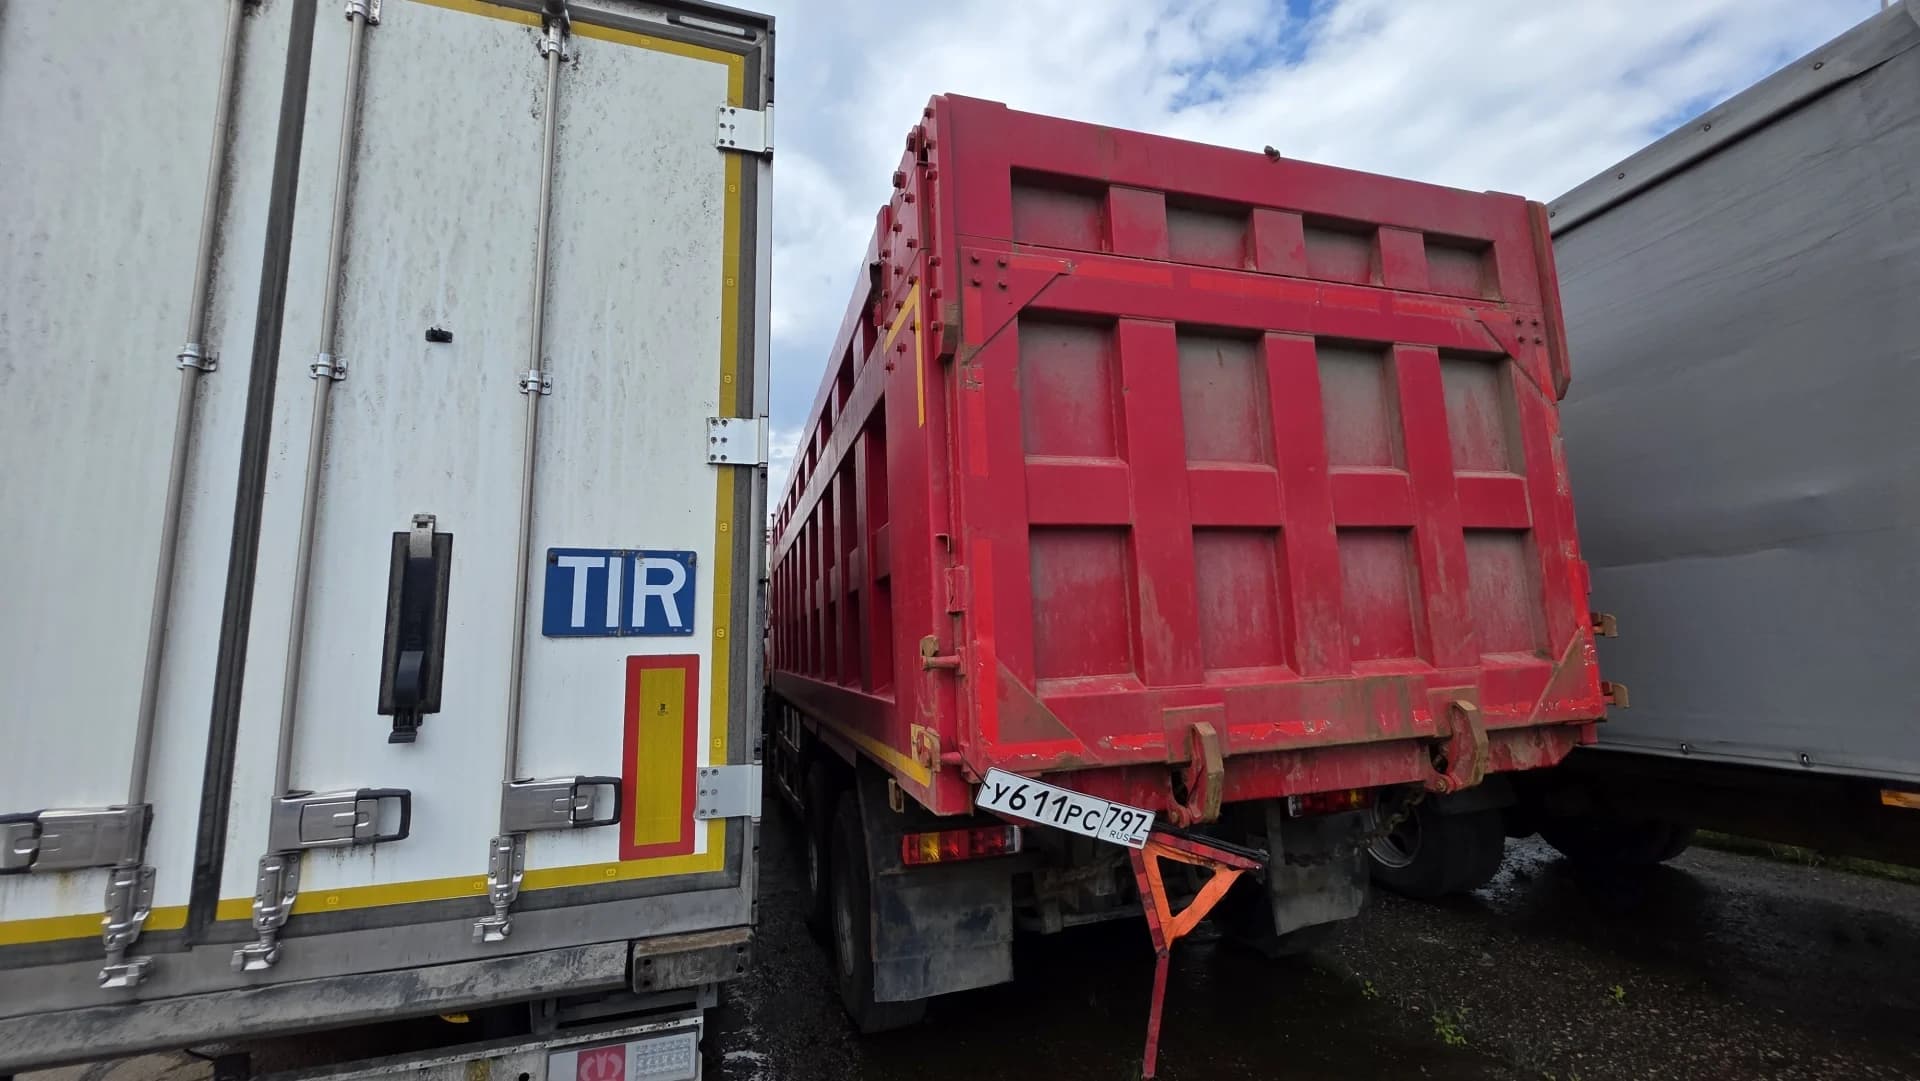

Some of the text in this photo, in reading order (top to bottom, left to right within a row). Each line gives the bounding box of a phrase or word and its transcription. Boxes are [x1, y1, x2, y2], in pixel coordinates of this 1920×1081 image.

[558, 555, 687, 627] TIR
[1105, 806, 1147, 834] 797
[1109, 830, 1130, 842] RUS
